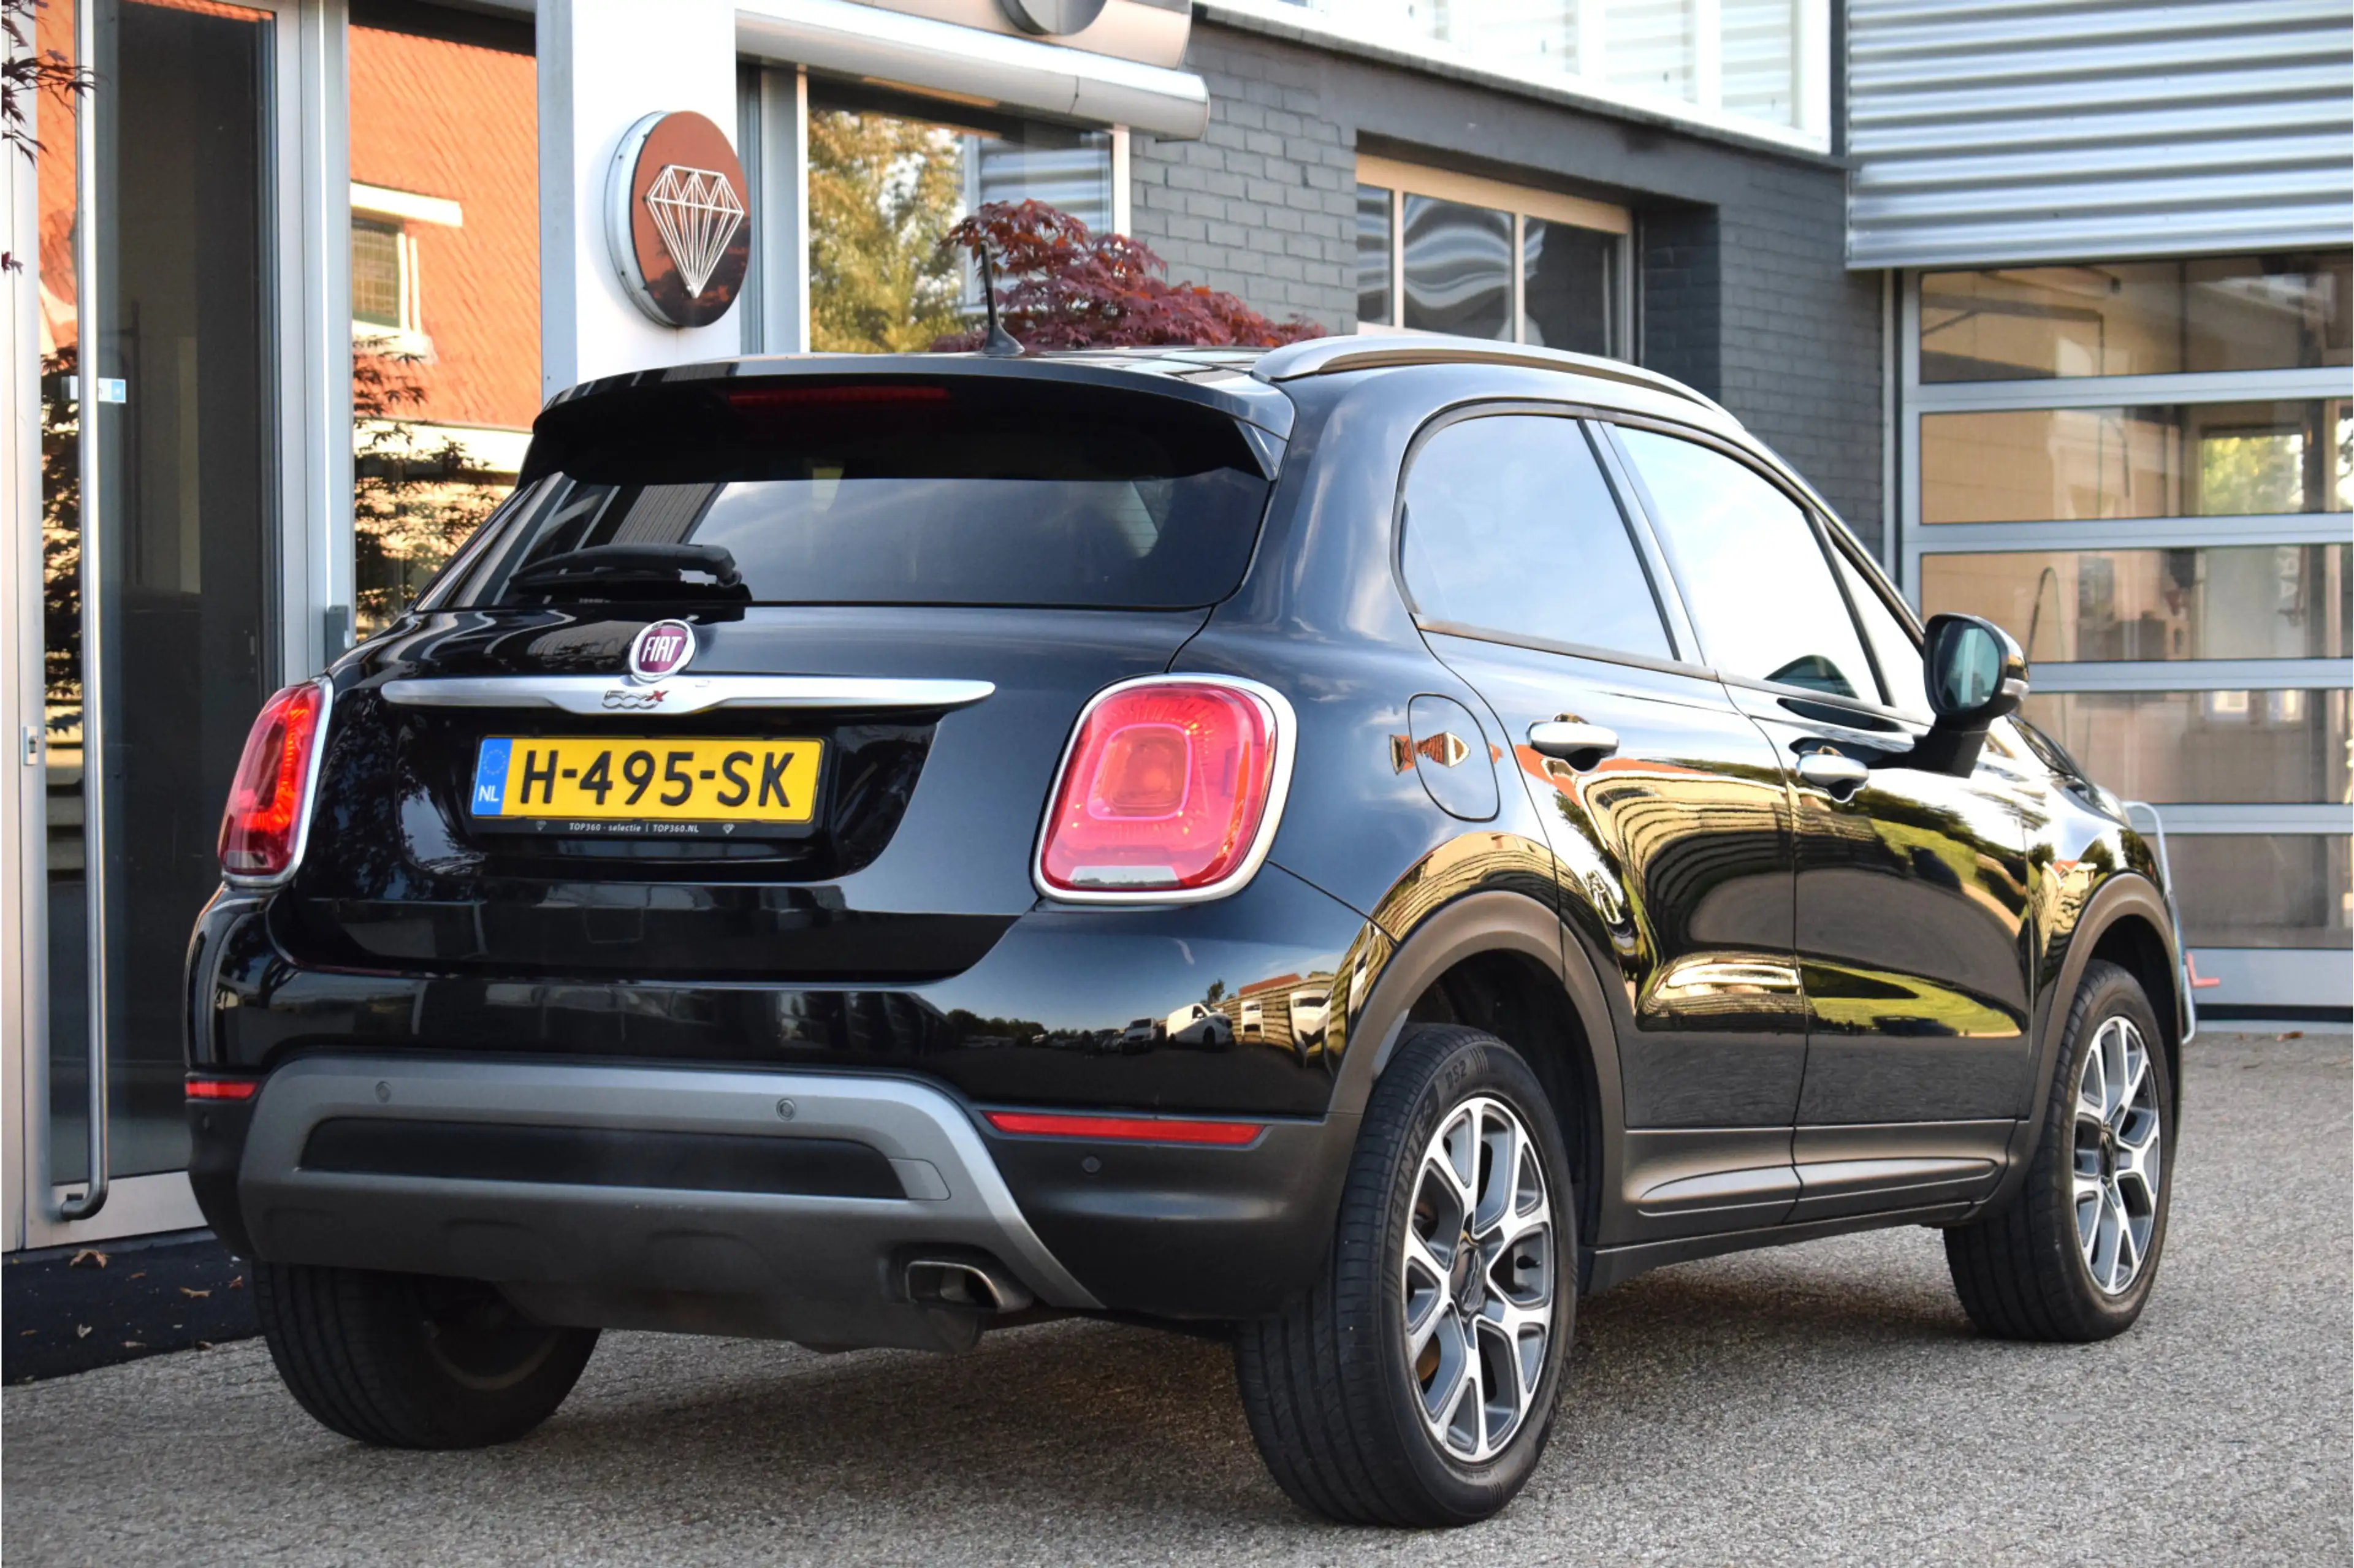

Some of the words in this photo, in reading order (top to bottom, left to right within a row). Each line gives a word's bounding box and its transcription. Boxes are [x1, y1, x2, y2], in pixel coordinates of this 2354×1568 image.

[641, 636, 682, 663] FIAT
[519, 750, 795, 807] H-495-SK
[478, 785, 500, 802] NL
[569, 823, 601, 832] TOP360
[608, 823, 642, 832] selectie
[653, 824, 699, 834] TOP360.NL
